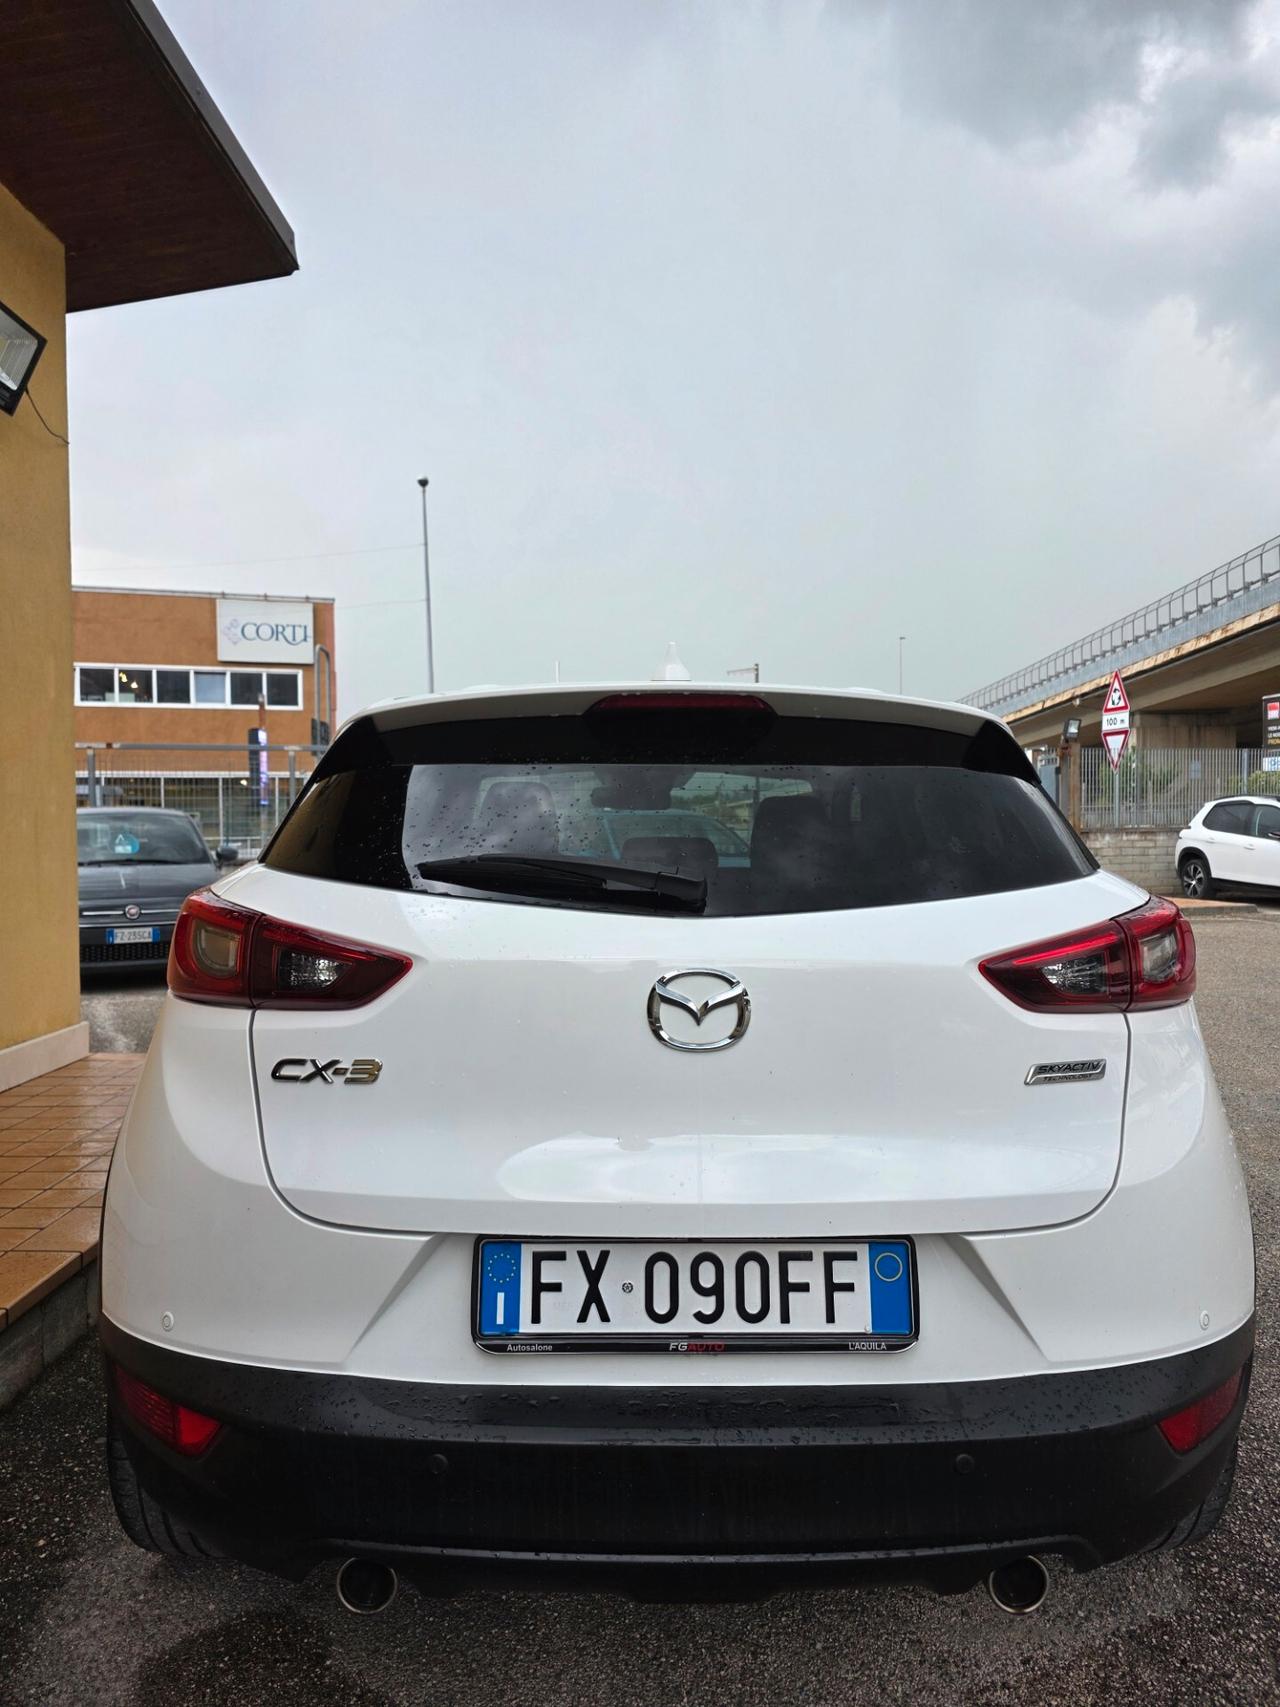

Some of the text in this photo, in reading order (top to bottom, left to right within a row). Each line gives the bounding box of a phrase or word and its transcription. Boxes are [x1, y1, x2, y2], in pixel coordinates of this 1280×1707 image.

[241, 622, 308, 646] CORTI
[1107, 717, 1118, 727] 100
[271, 1058, 383, 1084] CX-3
[1038, 1060, 1101, 1074] SKYACTIV
[530, 1249, 612, 1325] FX
[644, 1249, 859, 1325] 090FF
[506, 1343, 553, 1352] Autosalone
[848, 1342, 887, 1351] L'AQUILA
